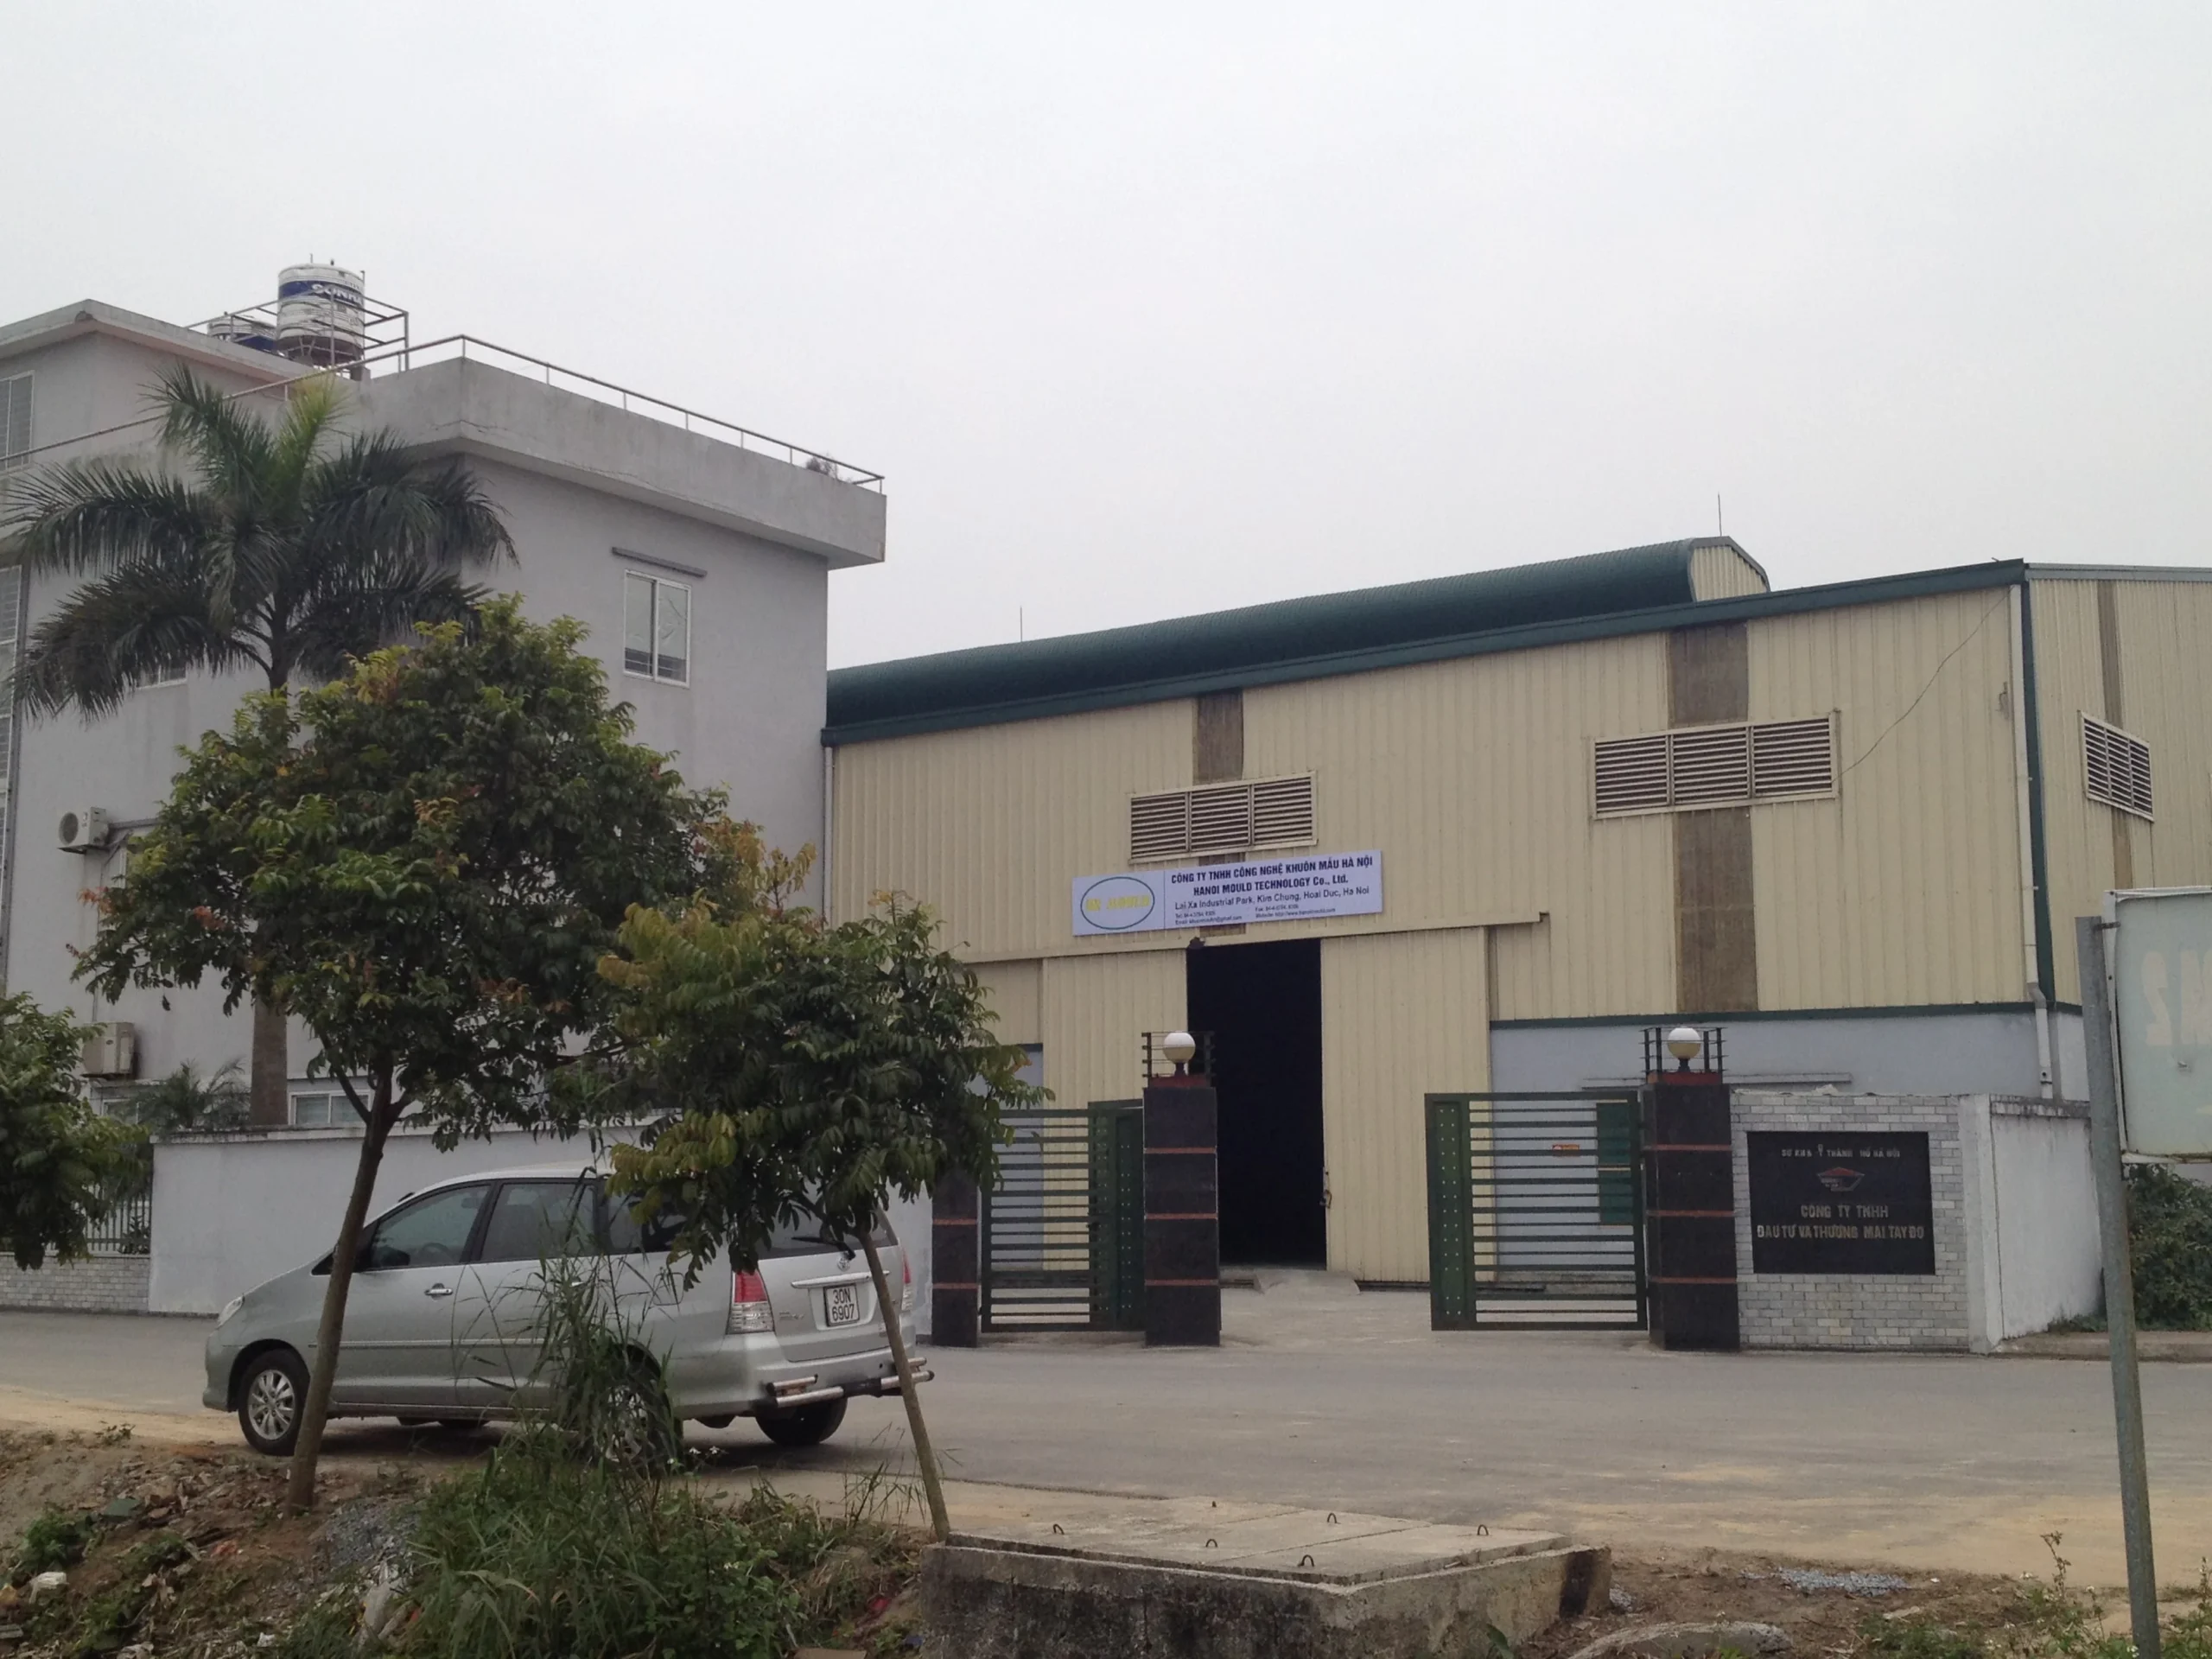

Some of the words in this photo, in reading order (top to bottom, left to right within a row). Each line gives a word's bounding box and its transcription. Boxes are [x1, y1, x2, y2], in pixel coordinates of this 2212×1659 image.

[1172, 873, 1194, 884] CÔNG
[1197, 872, 1206, 881] TY
[1209, 870, 1231, 880] TNHH
[1234, 867, 1257, 878] CÔNG
[1260, 863, 1283, 876] NGHỆ
[1286, 861, 1316, 874] KHUÔN
[1342, 856, 1354, 868] HÀ
[1357, 855, 1373, 868] NỘI
[1193, 885, 1219, 896] HANOI
[1223, 882, 1252, 893] MOULD
[1255, 877, 1311, 891] TECHNOLOGY
[1332, 874, 1349, 884] Ltd.
[1199, 898, 1234, 908] Industrial
[1236, 896, 1255, 905] Park,
[1274, 892, 1301, 902] Chung,
[1323, 889, 1341, 898] Duc,
[1344, 887, 1354, 896] Ha
[1356, 886, 1370, 895] Noi
[1838, 1205, 1851, 1217] TY
[1857, 1205, 1889, 1217] TNHH
[833, 1287, 851, 1304] 30N
[832, 1303, 855, 1321] 6907
